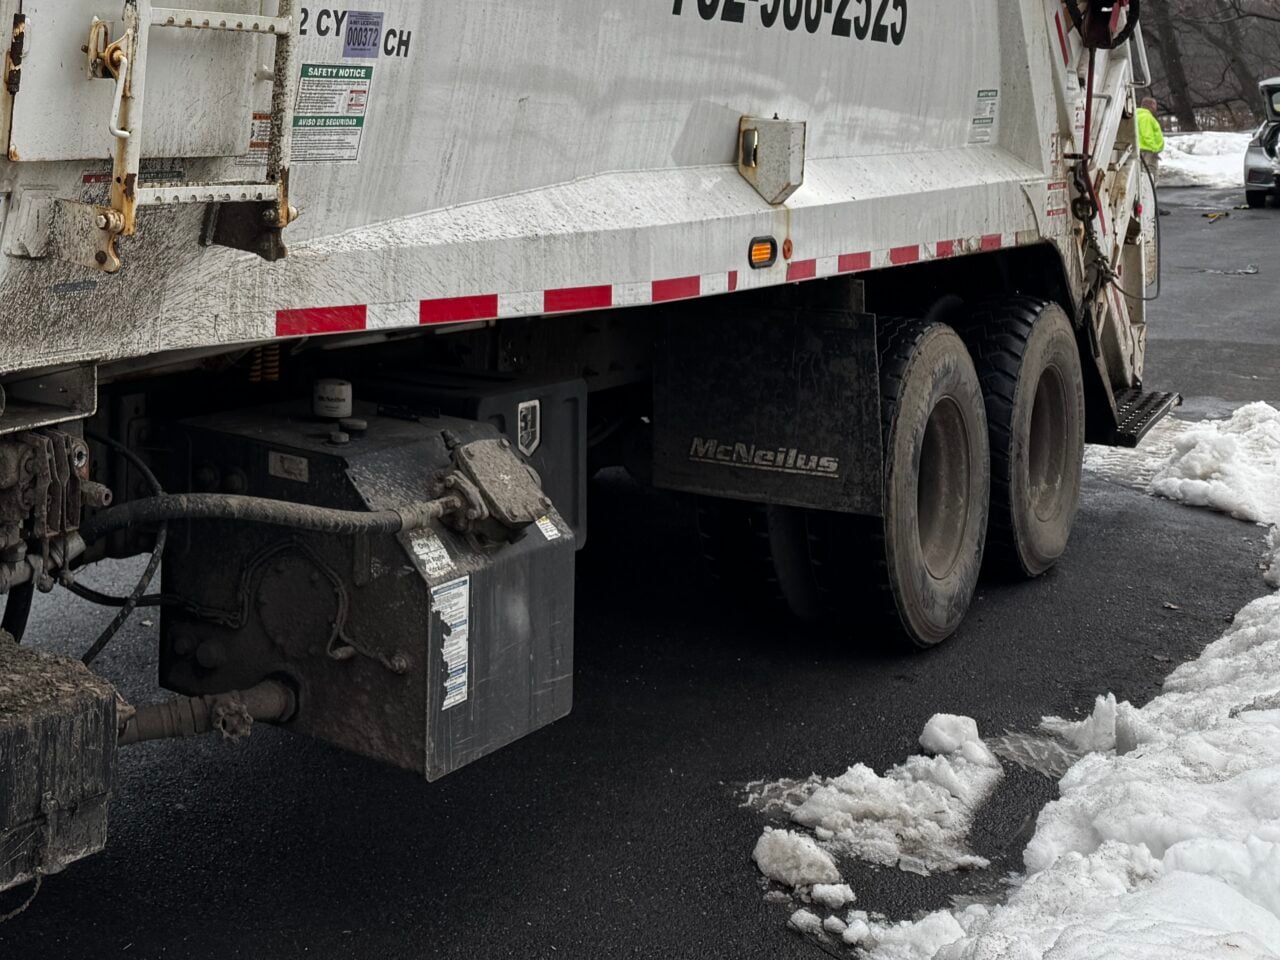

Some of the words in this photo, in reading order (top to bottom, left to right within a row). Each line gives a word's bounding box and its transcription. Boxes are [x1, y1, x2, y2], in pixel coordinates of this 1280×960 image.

[316, 8, 348, 37] CY
[347, 26, 379, 48] 000372
[308, 67, 337, 77] SAFETY
[339, 68, 366, 78] NOTICE
[298, 118, 316, 126] AVISO
[317, 118, 325, 126] DE
[326, 118, 357, 126] SEGURIDAD
[689, 437, 839, 474] McNeilus
